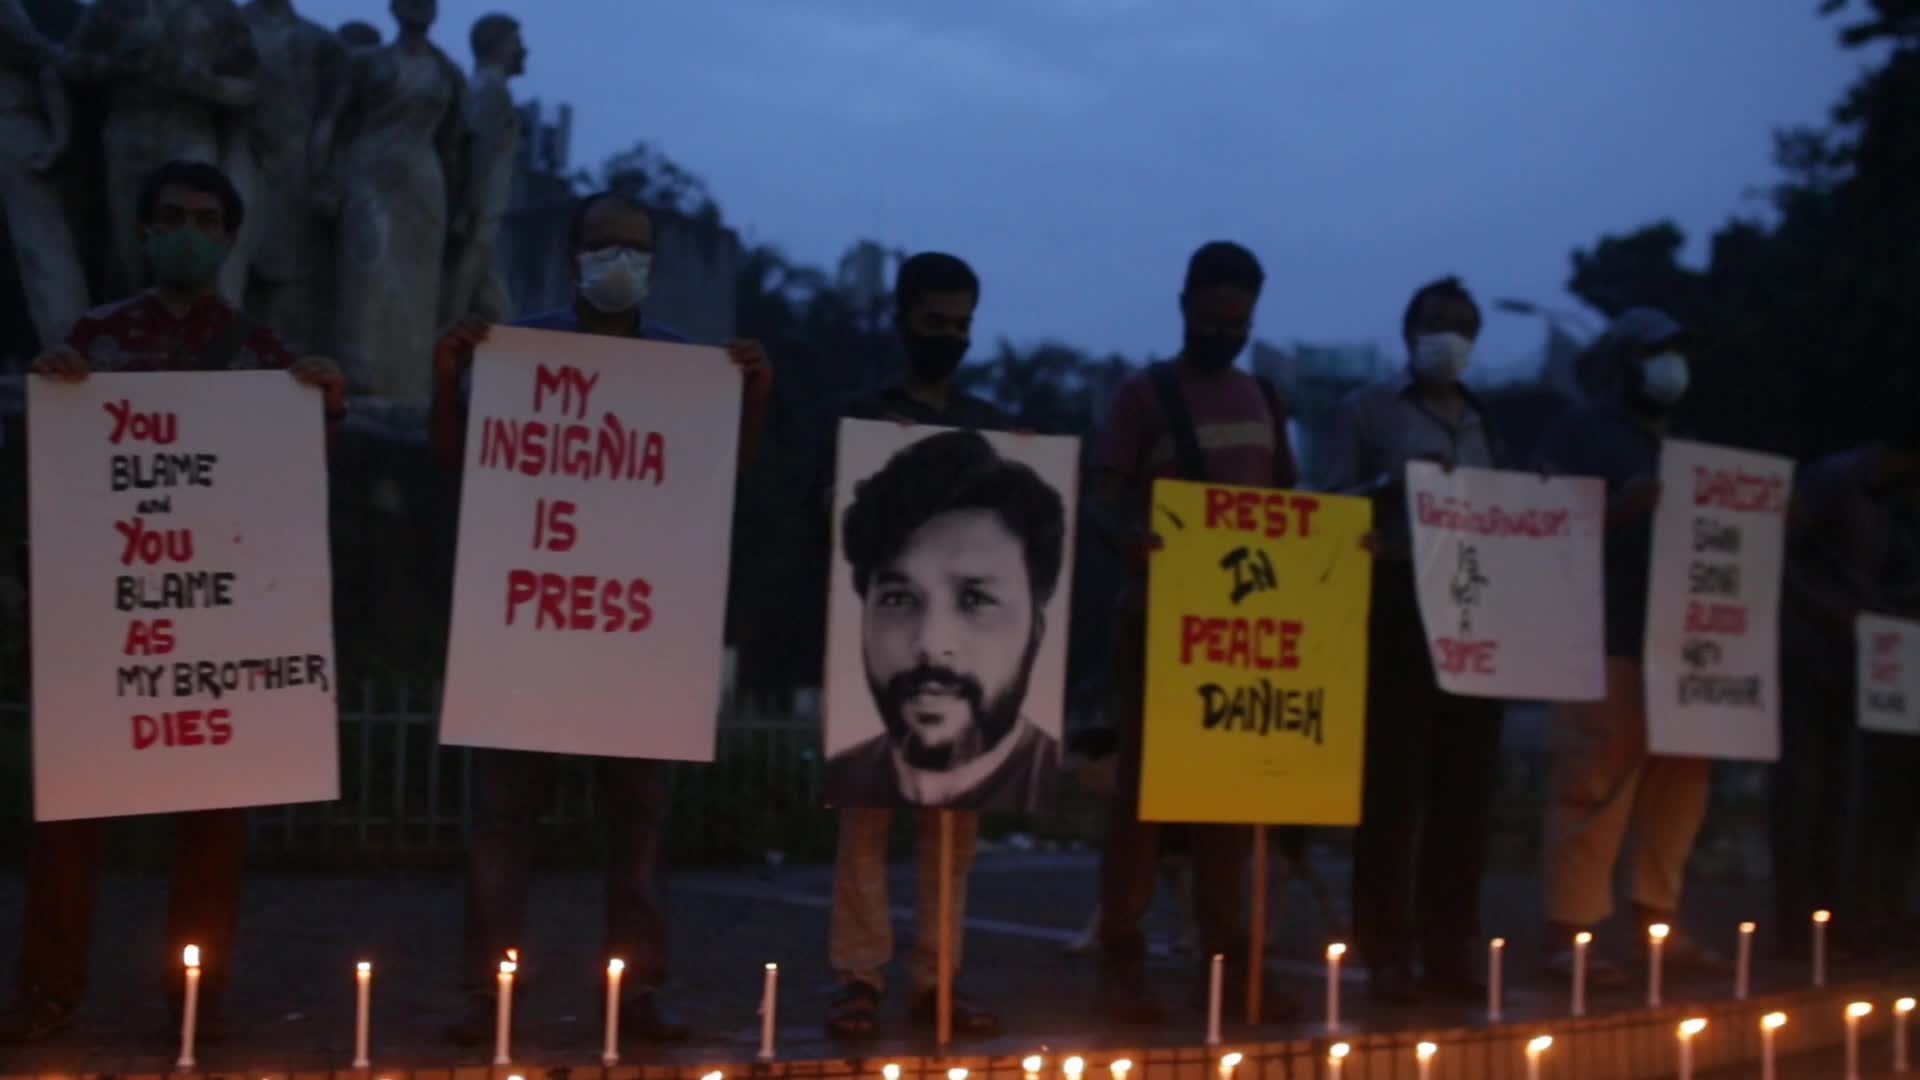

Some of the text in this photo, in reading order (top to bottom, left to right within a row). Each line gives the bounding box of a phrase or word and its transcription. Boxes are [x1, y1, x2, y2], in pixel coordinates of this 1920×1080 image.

[534, 364, 598, 419] MY
[112, 453, 217, 492] BLAME
[137, 496, 171, 513] and
[533, 498, 577, 552] IS
[1206, 488, 1319, 538] REST
[115, 517, 193, 565] YOU
[116, 572, 235, 611] BLAME
[1220, 546, 1278, 605] IN
[506, 569, 653, 632] PRESS
[124, 619, 175, 655] AS
[1180, 614, 1304, 670] PEACE
[117, 654, 329, 698] MY BROTHER
[132, 709, 232, 749] DIES
[1198, 678, 1324, 745] DANISH
